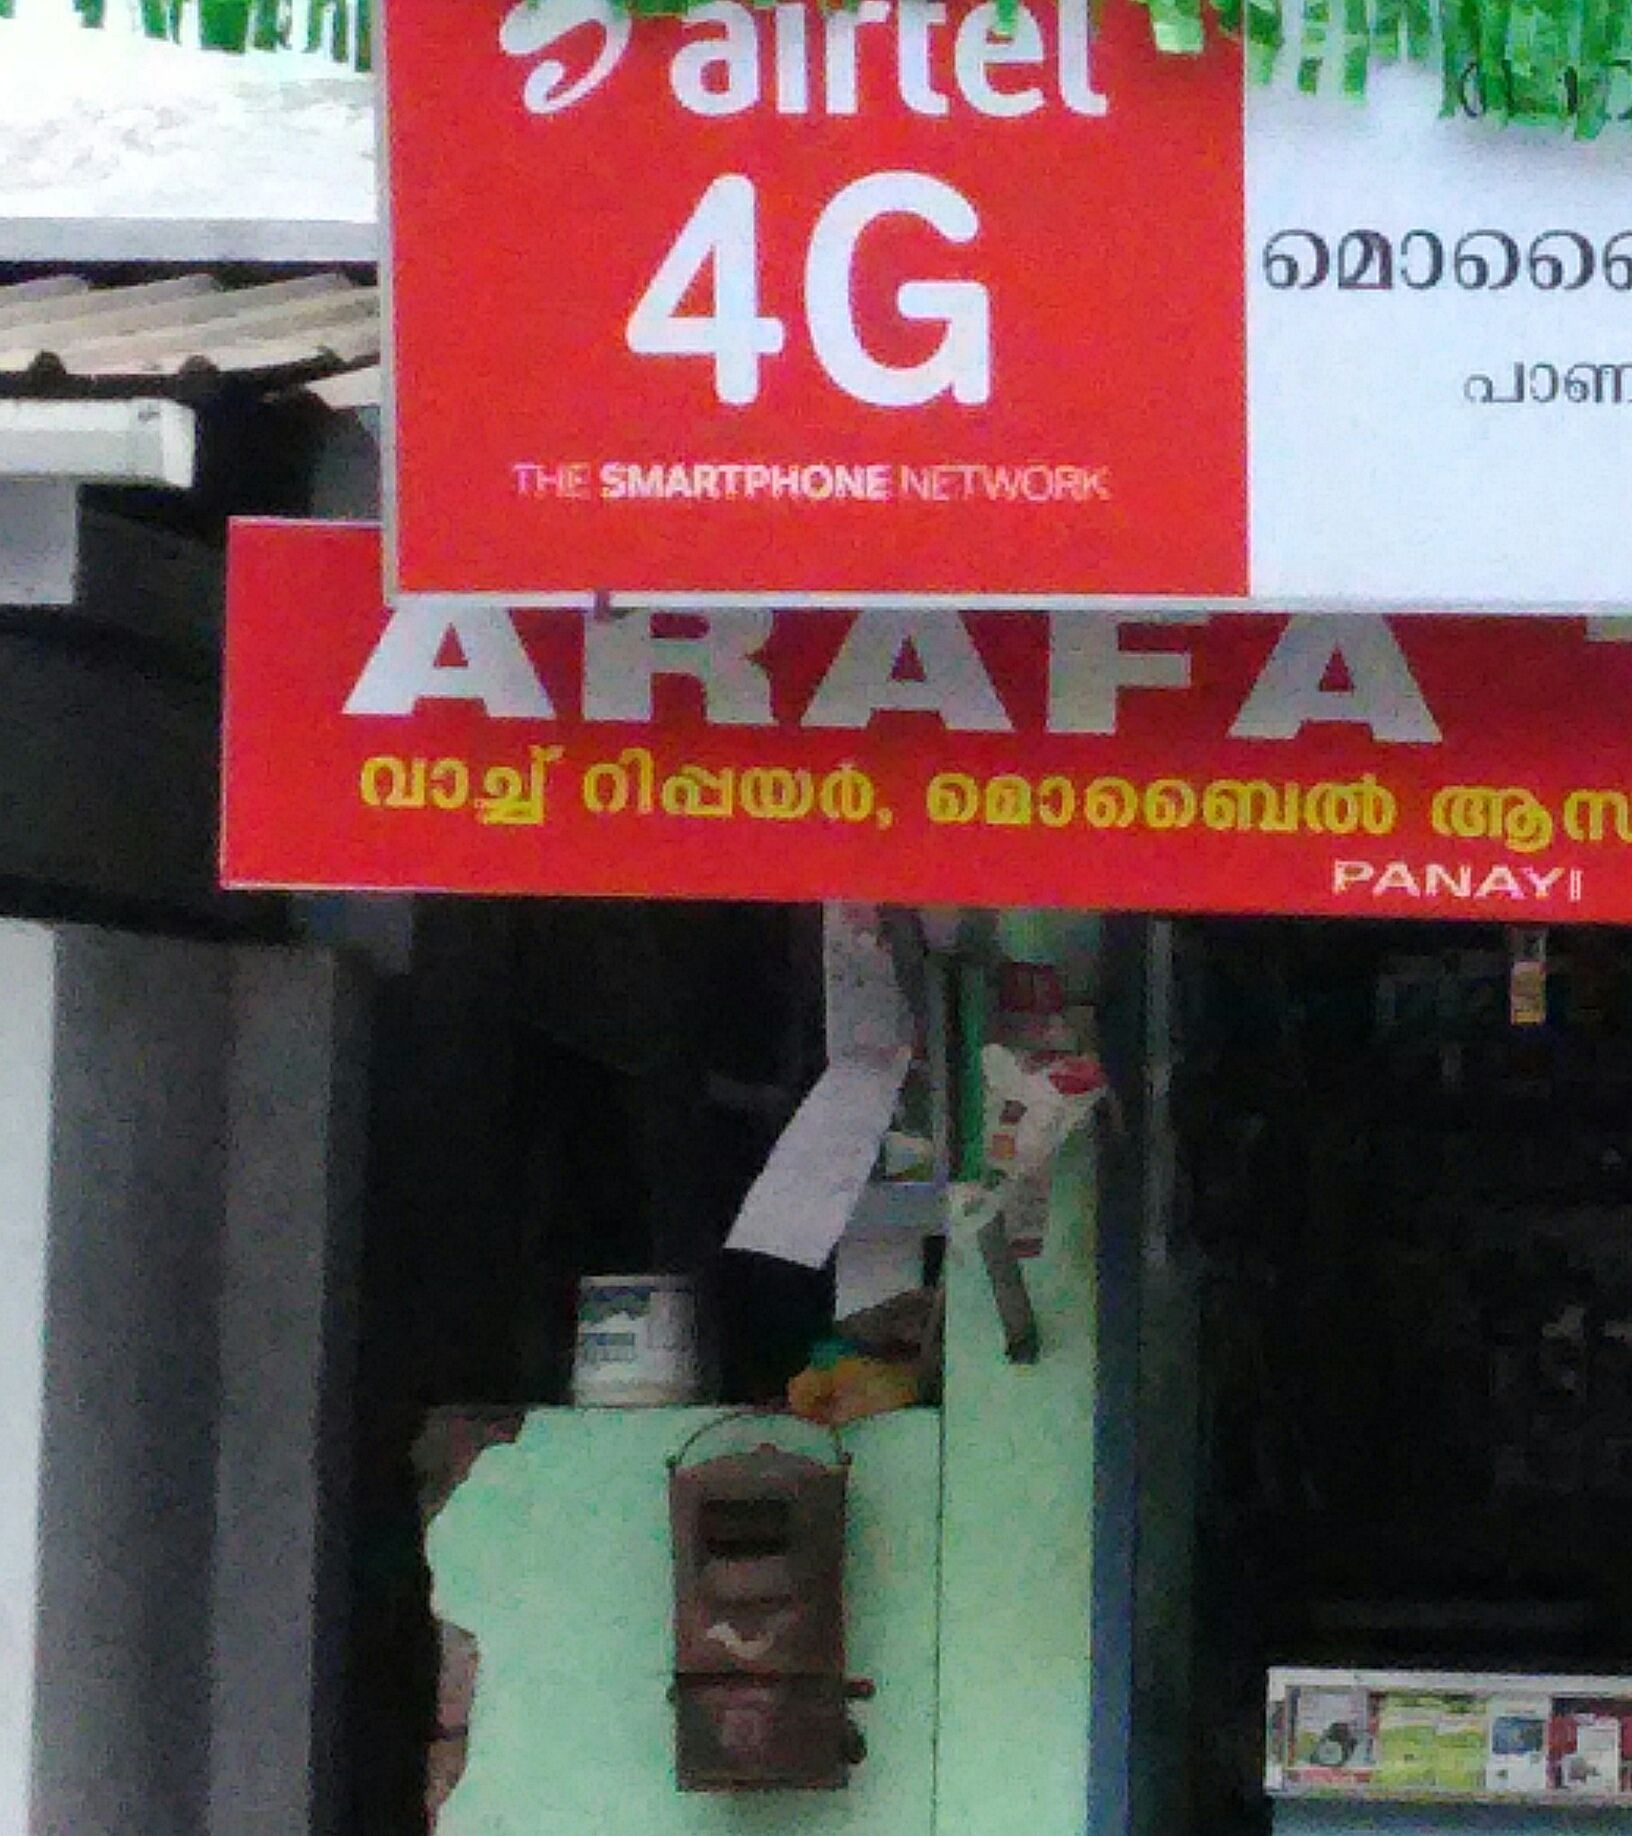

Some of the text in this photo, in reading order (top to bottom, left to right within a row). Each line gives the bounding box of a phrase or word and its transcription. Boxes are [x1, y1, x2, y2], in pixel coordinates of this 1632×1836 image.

[670, 0, 1108, 117] airtel
[625, 170, 992, 408] 4G
[511, 462, 1109, 502] THE SMARTPHONE NETWORK
[340, 605, 1444, 744] ARAFA
[360, 745, 564, 826] വാച്ച്
[1332, 859, 1583, 902] PANAYI
